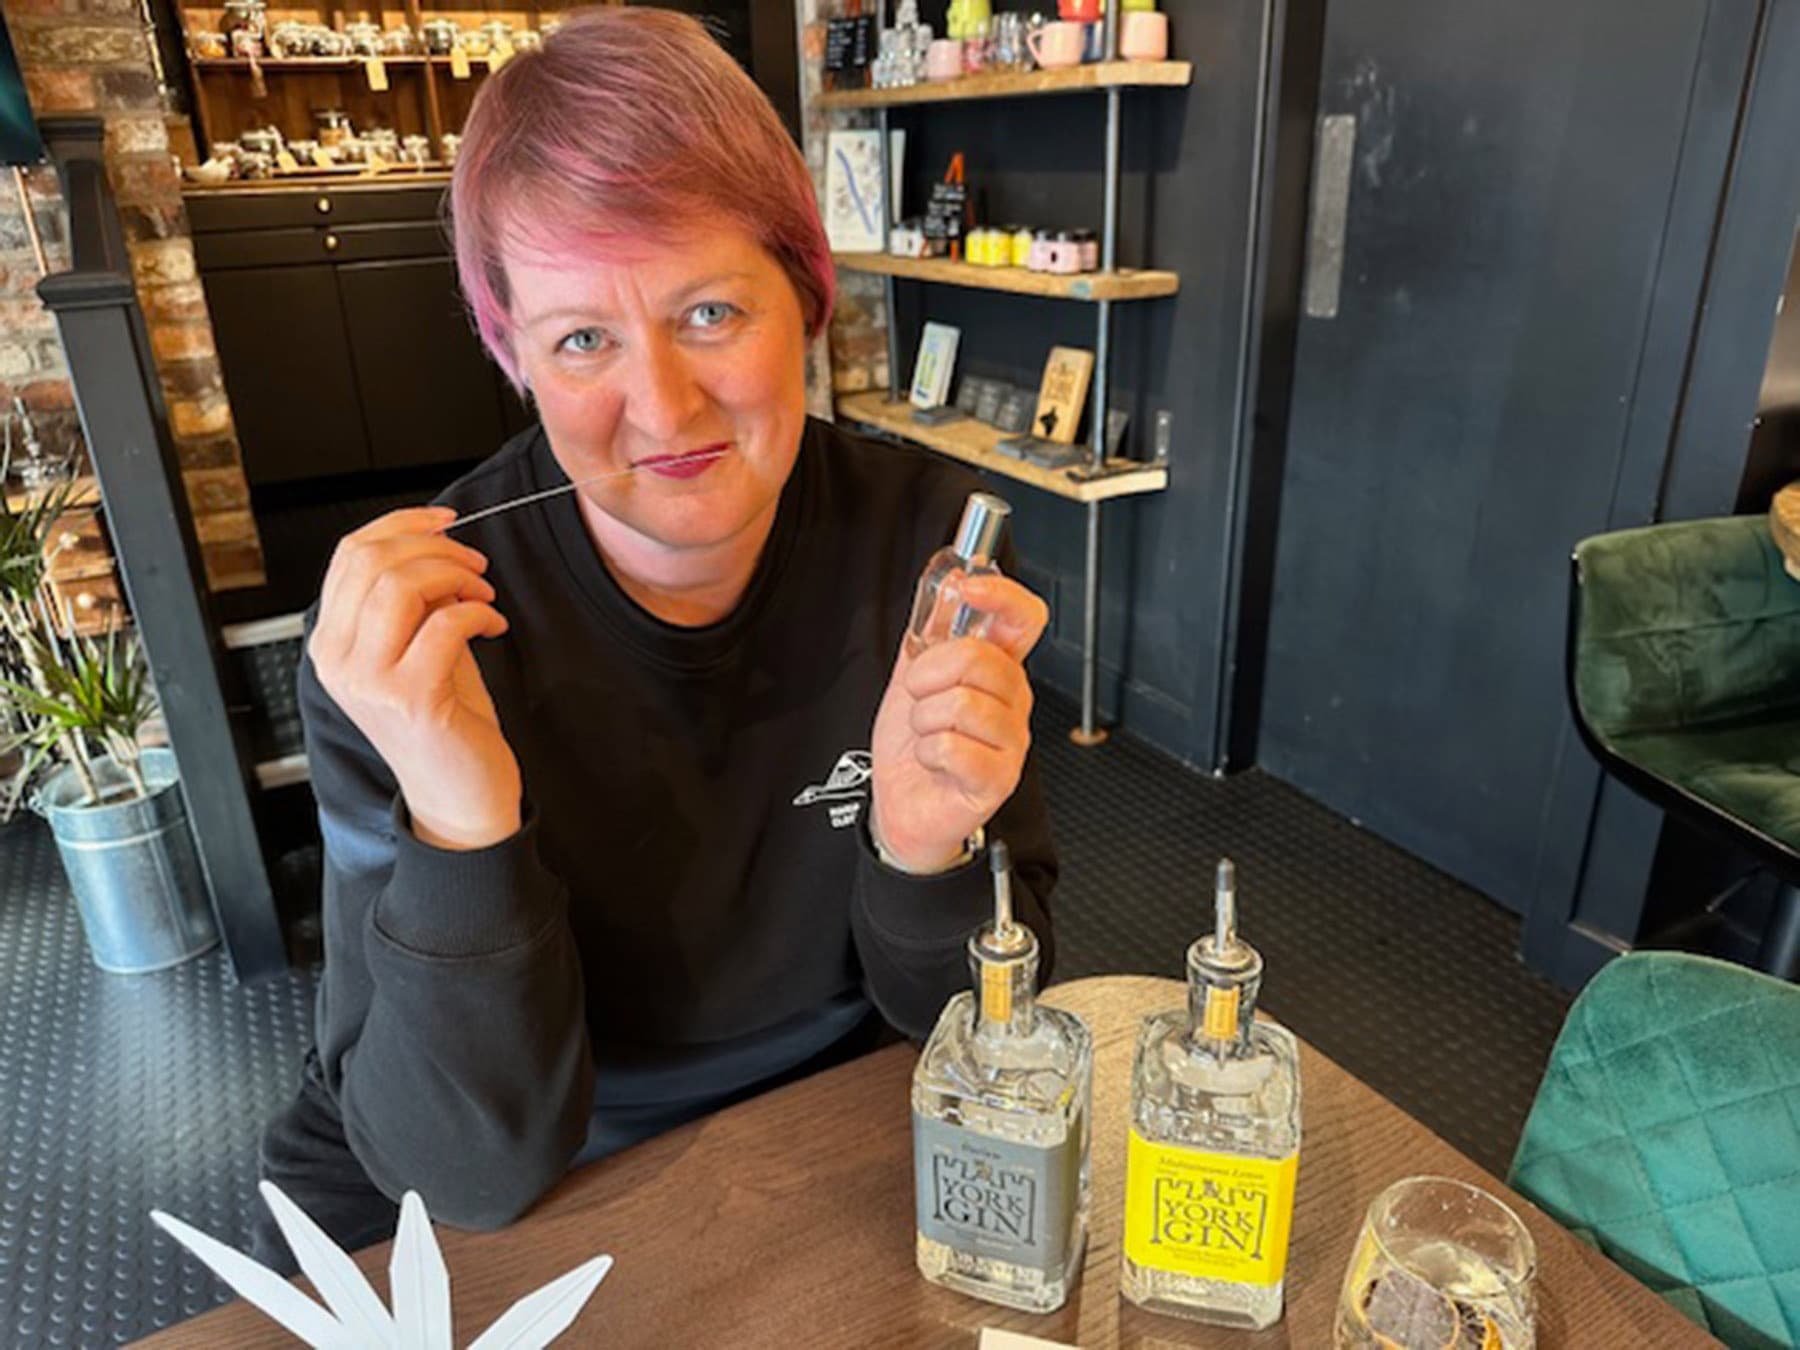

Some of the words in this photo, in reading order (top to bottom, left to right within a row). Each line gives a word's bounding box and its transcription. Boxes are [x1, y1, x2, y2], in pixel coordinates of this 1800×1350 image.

[943, 1176, 1025, 1217] YORK
[944, 1199, 1022, 1235] GIN
[1164, 1198, 1253, 1231] YORK
[1164, 1219, 1250, 1250] GIN
